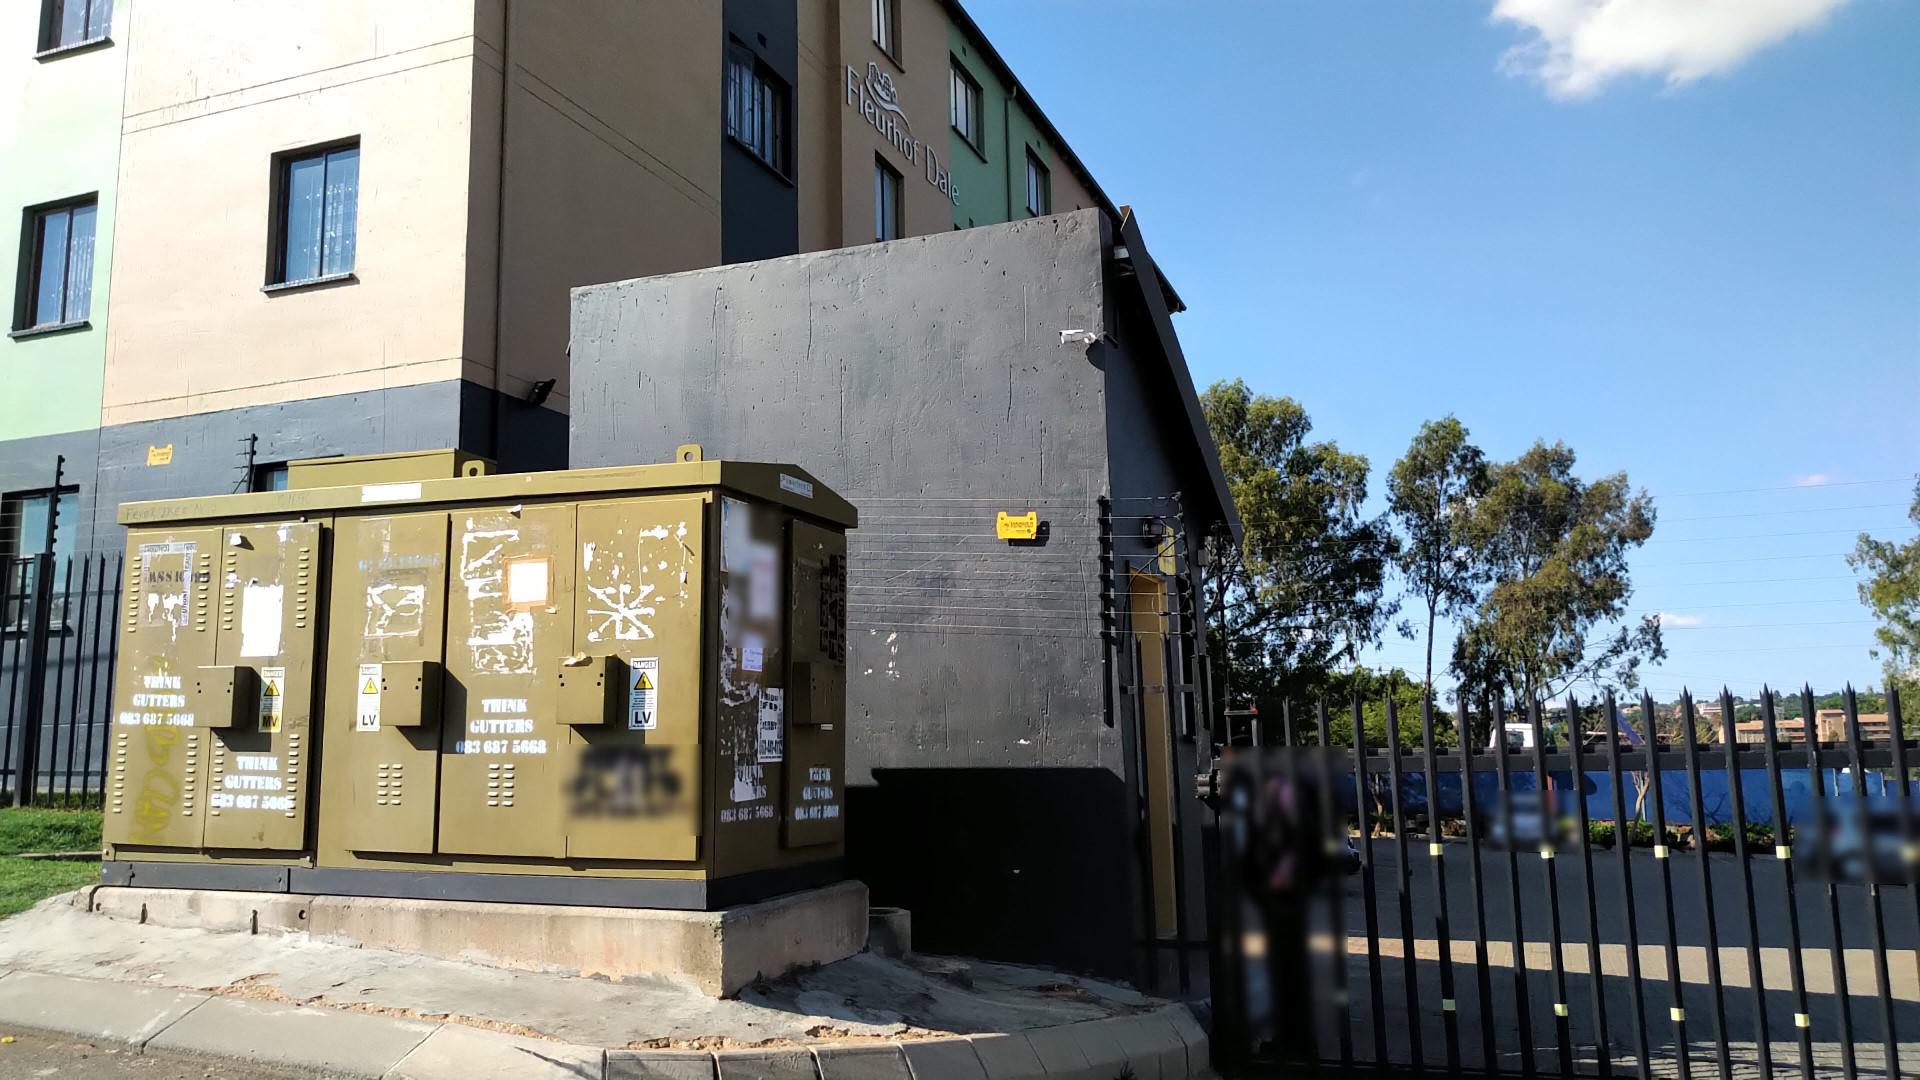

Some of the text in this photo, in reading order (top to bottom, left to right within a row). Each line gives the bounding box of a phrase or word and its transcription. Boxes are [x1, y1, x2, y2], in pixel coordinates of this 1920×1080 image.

[846, 64, 960, 207] Fleurhof Dale
[144, 676, 181, 689] THINK
[133, 694, 186, 707] GUTTERS
[481, 699, 528, 713] THINK
[143, 713, 163, 725] 687
[263, 715, 279, 728] MV
[362, 714, 376, 726] LV
[634, 712, 651, 725] LV
[470, 719, 534, 734] GUTTERS
[456, 740, 547, 754] 083 687 5668
[235, 756, 279, 770] THINK
[224, 775, 282, 790] GUTTERS
[720, 804, 774, 823] 083 687 5668
